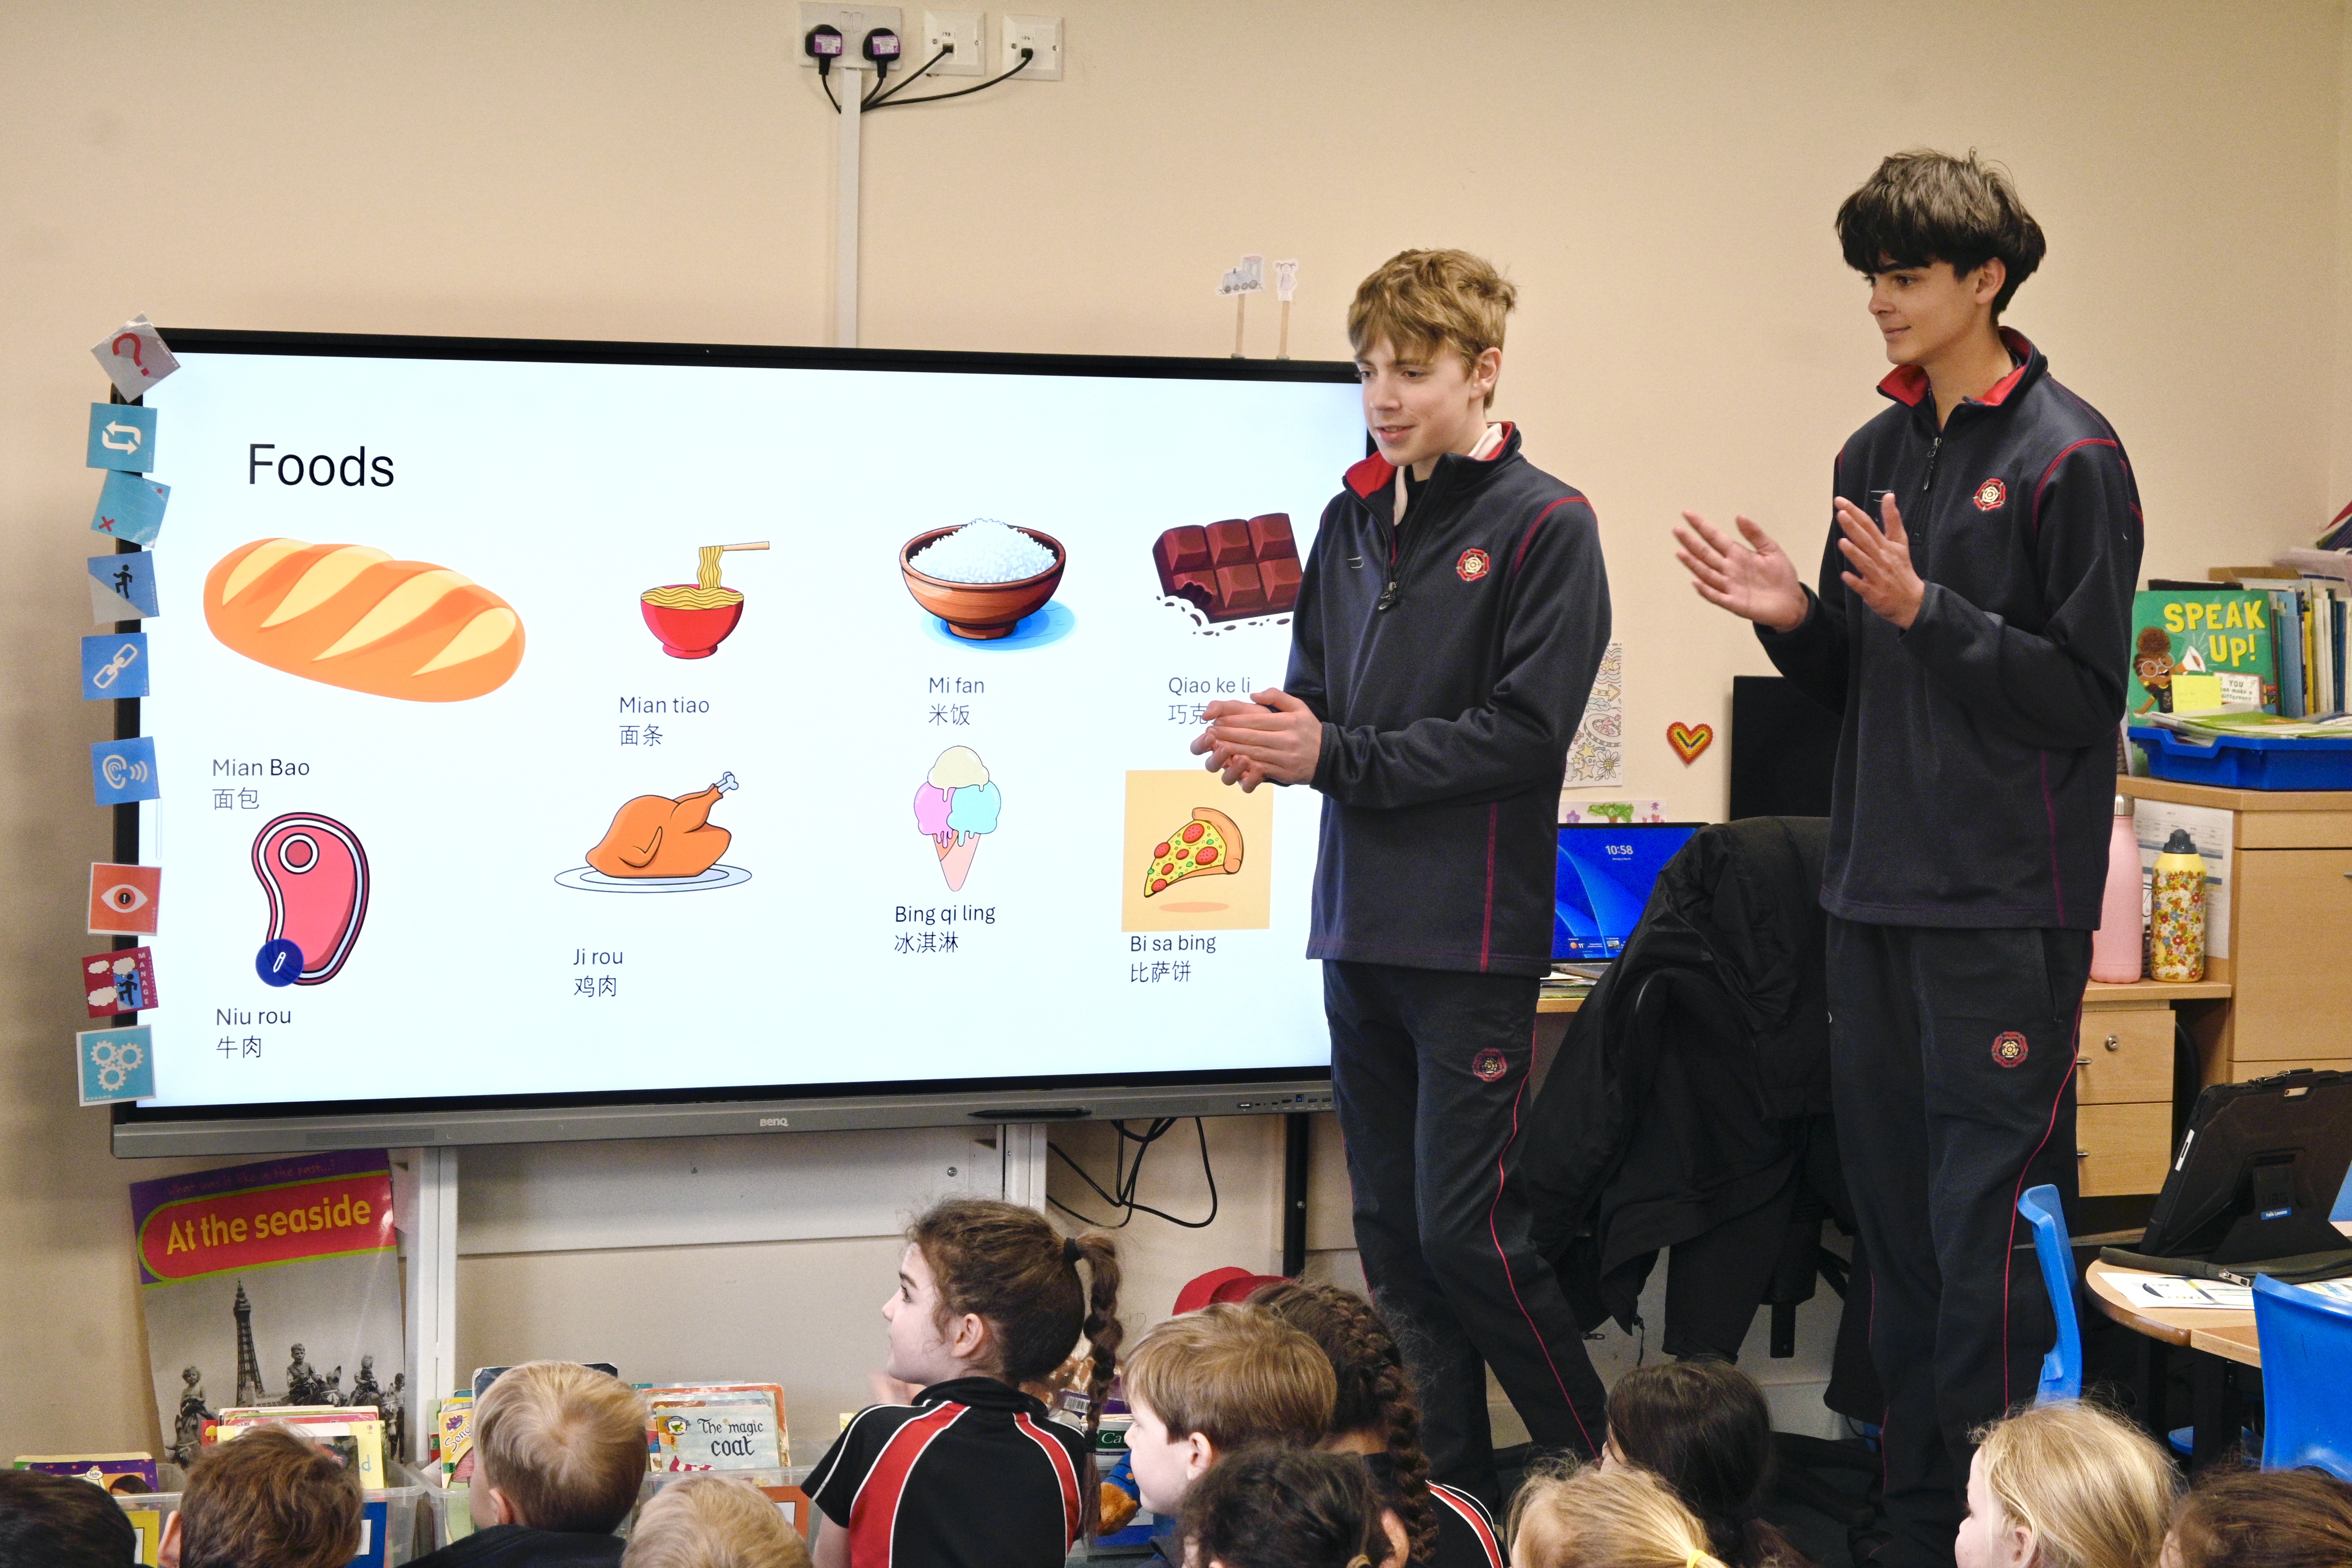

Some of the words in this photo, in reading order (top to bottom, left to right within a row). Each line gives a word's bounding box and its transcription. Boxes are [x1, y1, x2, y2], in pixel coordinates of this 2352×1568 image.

[249, 443, 394, 487] Foods
[2164, 600, 2266, 632] SPEAK
[2209, 634, 2256, 667] UP!
[929, 677, 950, 694] Mi
[955, 677, 984, 693] fan
[1168, 677, 1211, 696] Qiao
[1217, 677, 1236, 693] ke
[1242, 677, 1250, 693] li
[2229, 679, 2244, 687] YOU
[620, 696, 666, 713] Mian
[672, 696, 709, 713] tiao
[928, 703, 970, 726] 米饭
[1168, 703, 1214, 725] 巧克
[619, 724, 663, 747] 面条
[213, 759, 263, 776] Mian
[270, 759, 310, 776] Bao
[212, 787, 259, 810] 面包
[1606, 845, 1633, 855] 10:58
[896, 906, 936, 926] Bing
[941, 904, 957, 925] qi
[963, 904, 996, 924] ling
[894, 931, 959, 954] 冰淇淋
[1131, 935, 1146, 952] Bi
[1152, 939, 1172, 951] sa
[1179, 934, 1216, 954] bing
[573, 948, 585, 965] Ji
[592, 951, 623, 965] rou
[138, 952, 149, 1004] MANAGE
[1131, 960, 1192, 983] 比萨饼
[574, 975, 616, 998] 鸡肉
[216, 1007, 251, 1026] Niu
[259, 1010, 291, 1024] rou
[216, 1035, 261, 1059] 牛肉
[760, 1117, 788, 1127] BenQ
[274, 1166, 294, 1178] the
[167, 1220, 196, 1255] At
[200, 1214, 248, 1247] the
[255, 1194, 371, 1239] seaside
[445, 1422, 471, 1452] Song
[697, 1418, 722, 1435] The
[728, 1419, 764, 1436] magic
[1101, 1432, 1126, 1444] Ca
[711, 1436, 754, 1456] coat
